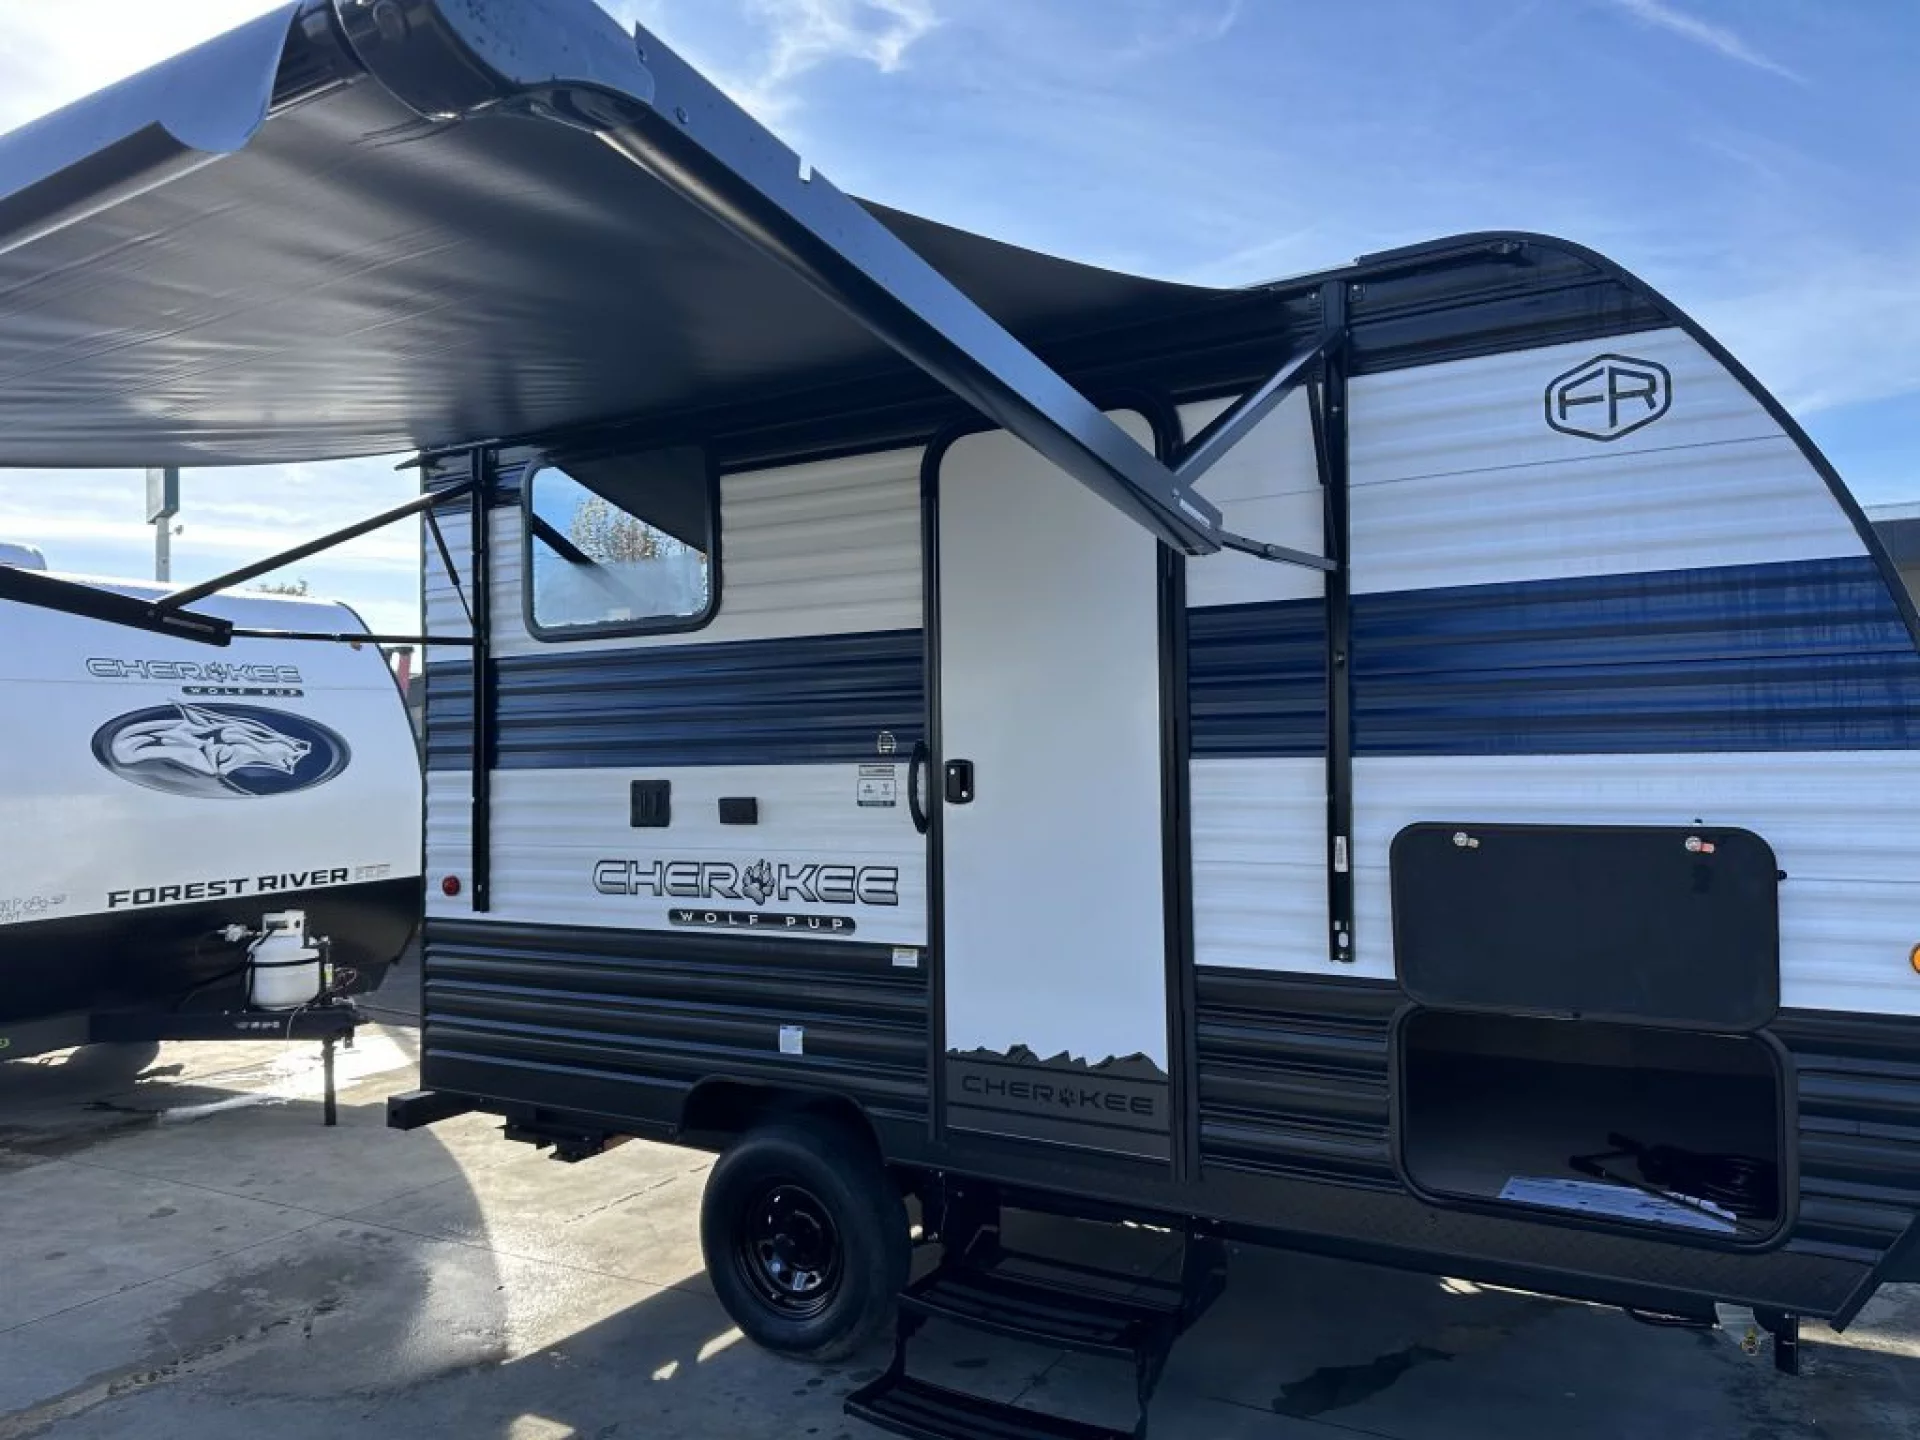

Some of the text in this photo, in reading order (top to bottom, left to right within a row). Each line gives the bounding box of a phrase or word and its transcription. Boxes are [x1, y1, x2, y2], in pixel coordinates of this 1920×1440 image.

[86, 657, 303, 683] CHEROKEE
[107, 878, 249, 908] FOREST
[257, 867, 348, 891] RIVER
[593, 859, 899, 906] CHEROKEE
[680, 911, 843, 930] WOLF PUP
[962, 1075, 1153, 1116] CHEROKEE
